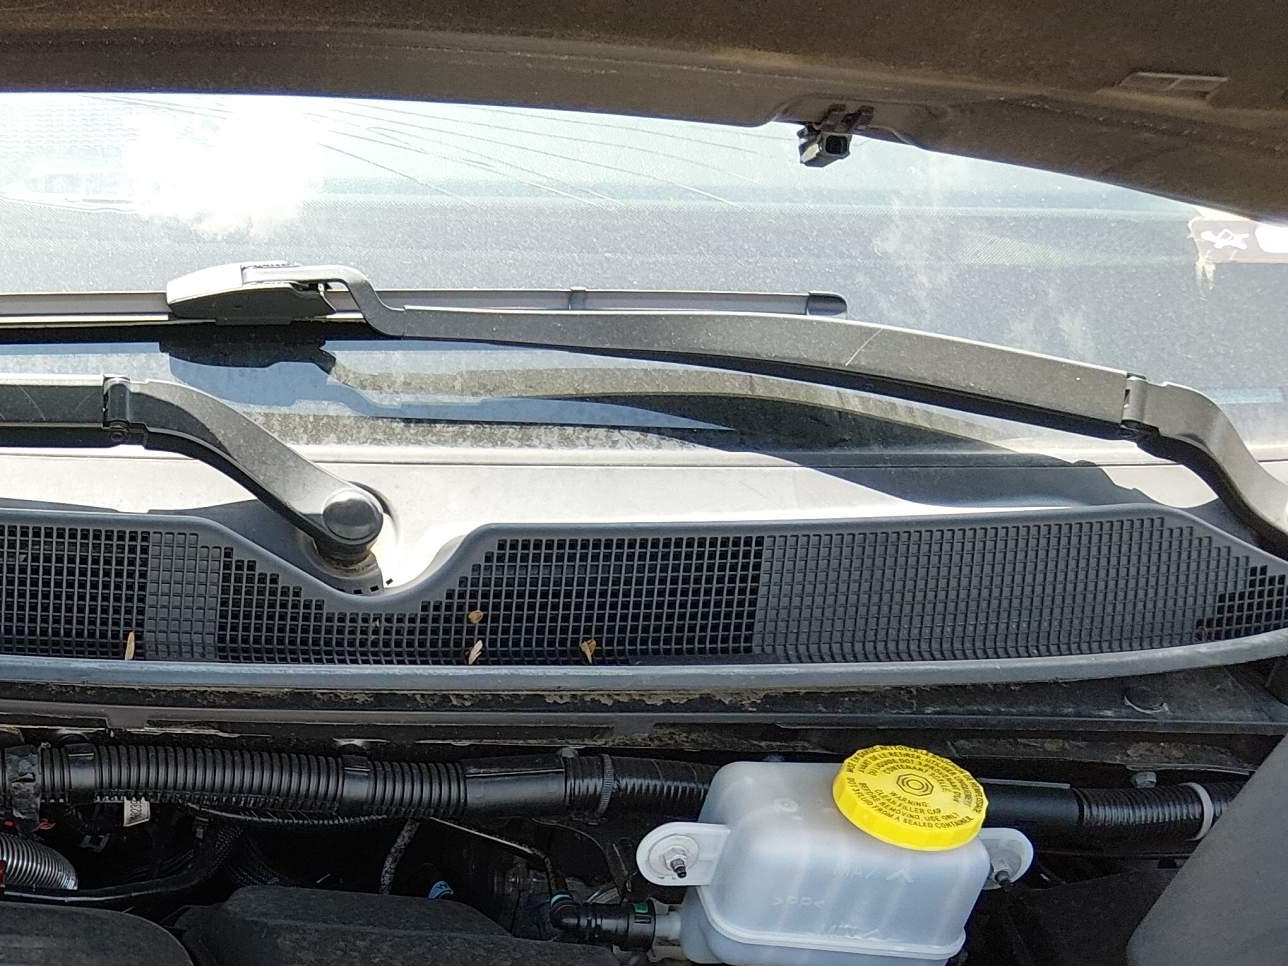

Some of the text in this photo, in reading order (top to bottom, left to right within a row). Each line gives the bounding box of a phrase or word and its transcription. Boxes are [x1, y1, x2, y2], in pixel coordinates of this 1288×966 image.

[872, 805, 895, 818] FROM
[902, 817, 934, 828] SEALED
[934, 816, 975, 829] CONTAINER
[897, 803, 925, 815] FILLER
